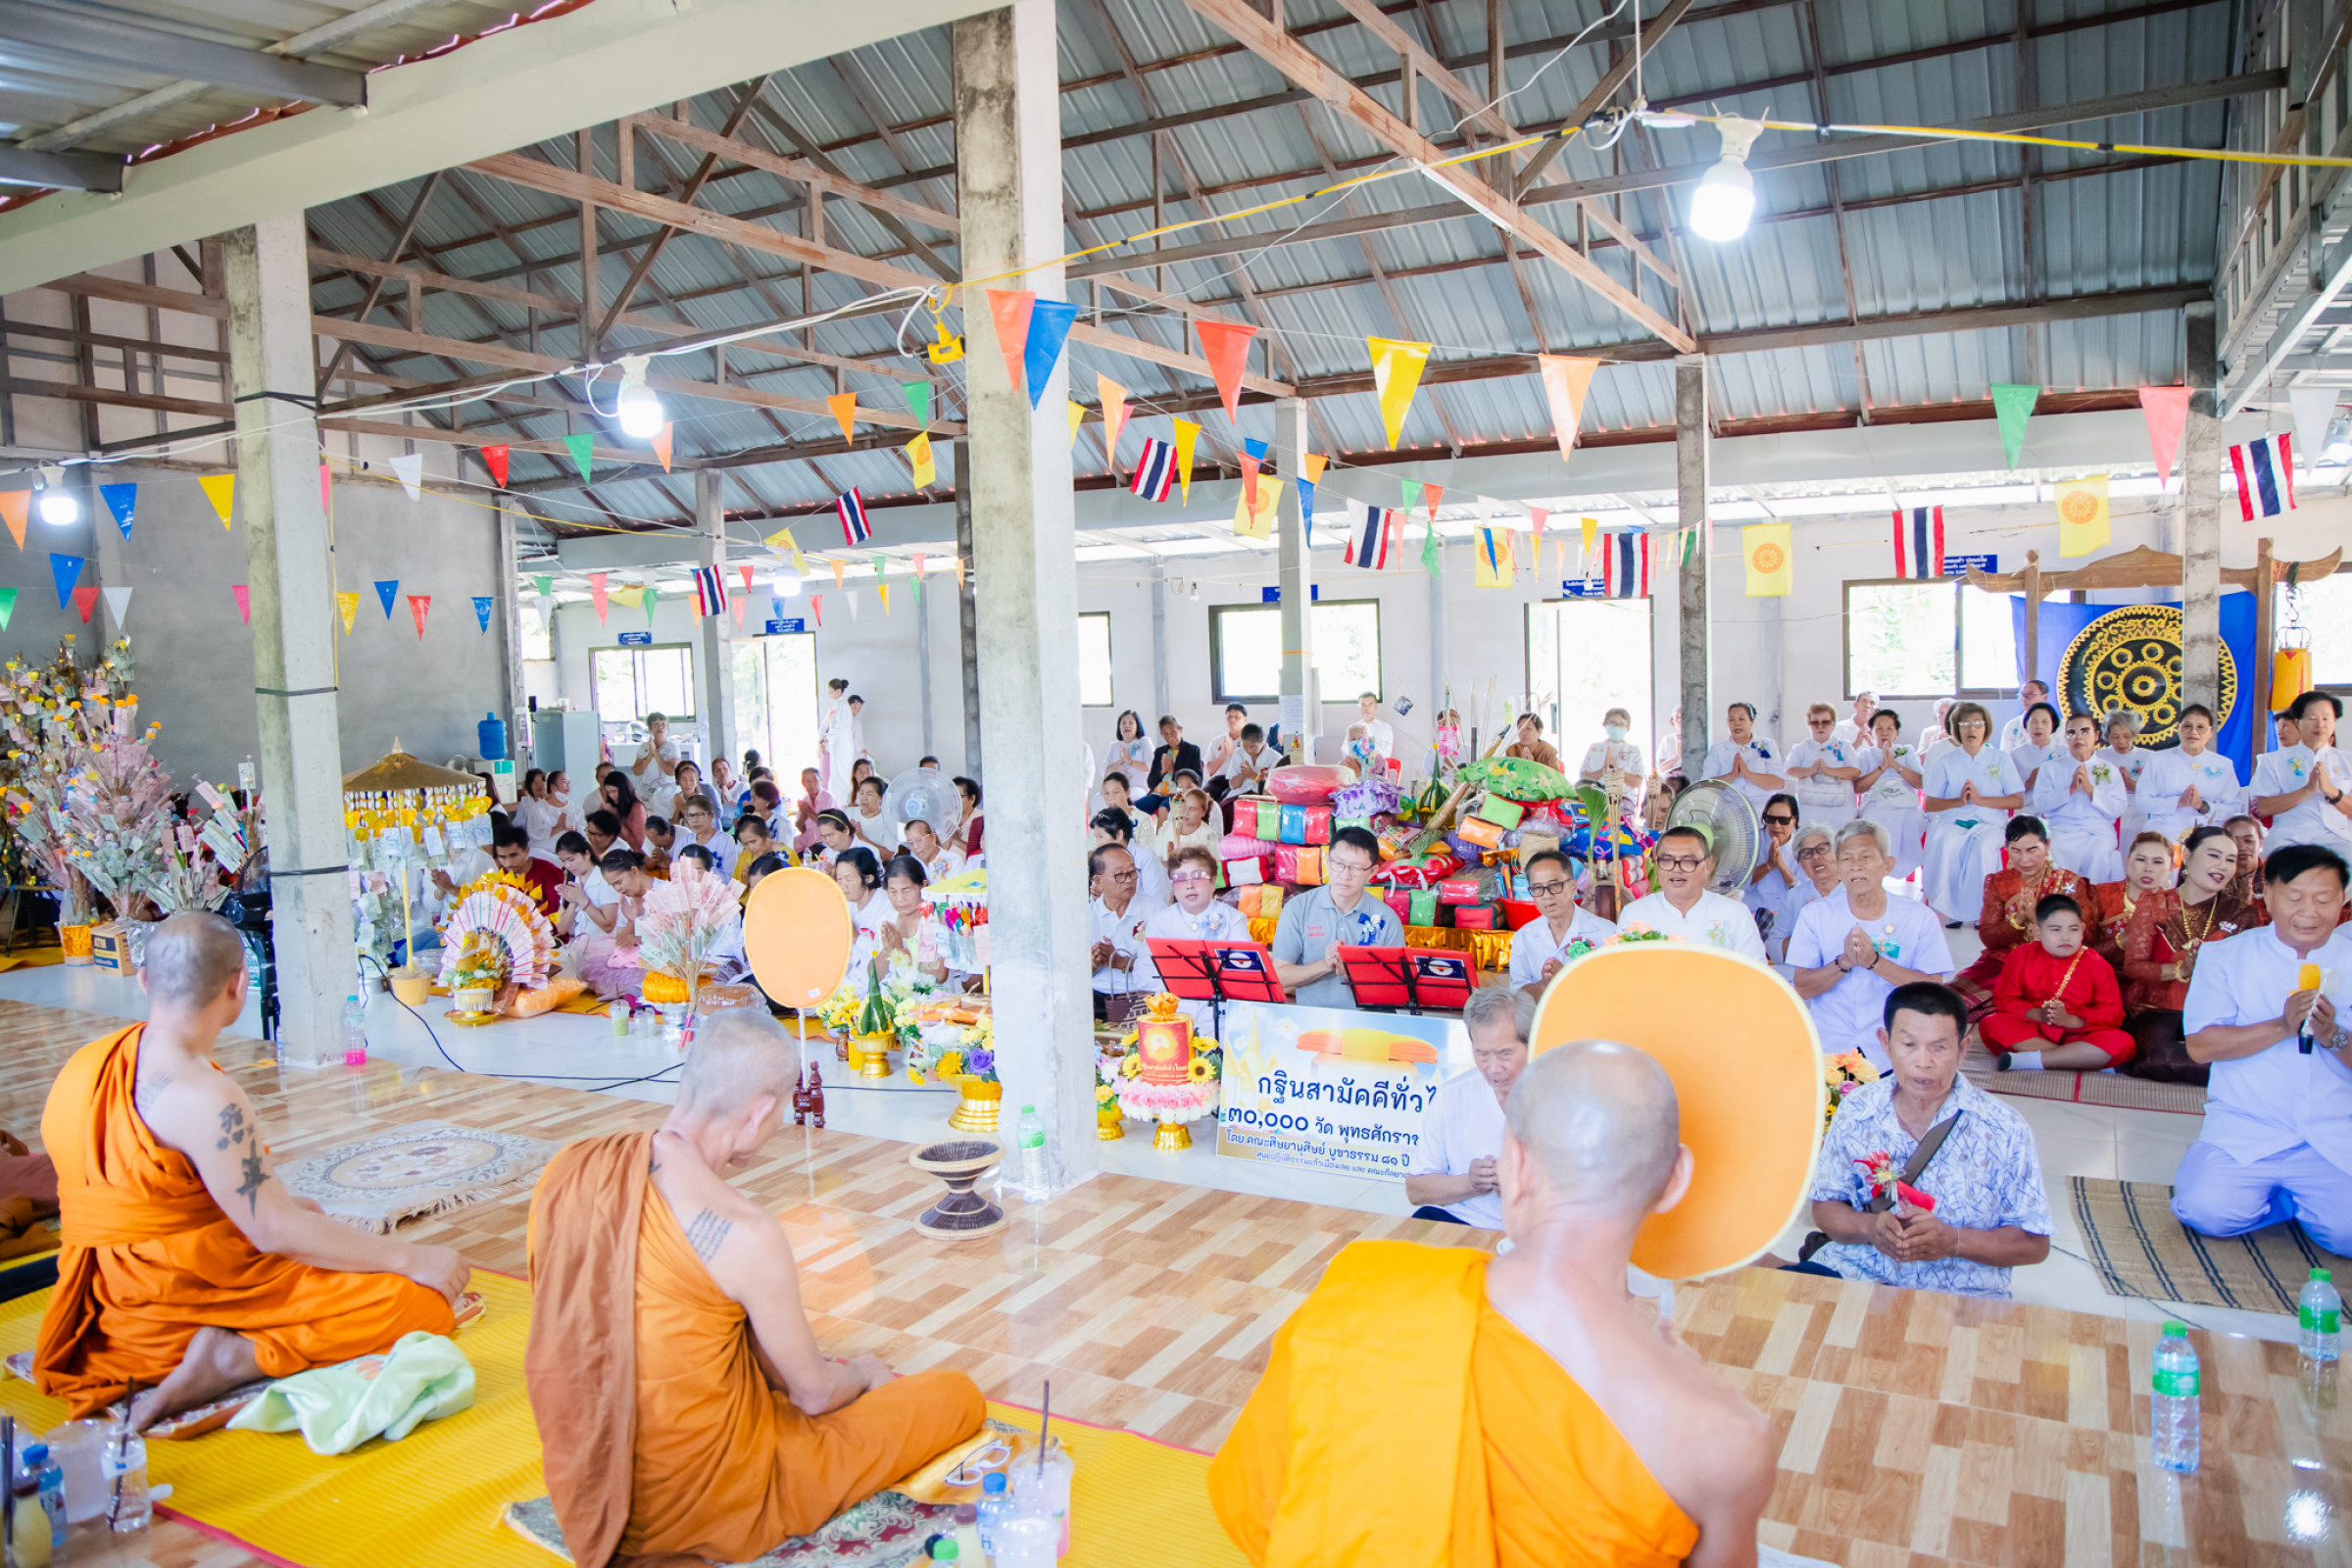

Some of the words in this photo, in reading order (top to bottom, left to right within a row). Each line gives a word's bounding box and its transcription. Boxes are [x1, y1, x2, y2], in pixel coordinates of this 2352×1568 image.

[1228, 1106, 1309, 1131] ๓๐,๐๐๐
[1315, 1116, 1334, 1135] วัด
[1225, 1128, 1245, 1144] โดย
[1247, 1135, 1326, 1156] คณะศิษยานุศิษย์
[1329, 1147, 1379, 1163] บูชาธรรม
[1381, 1154, 1398, 1166] ๘๑
[1401, 1152, 1410, 1167] ปี
